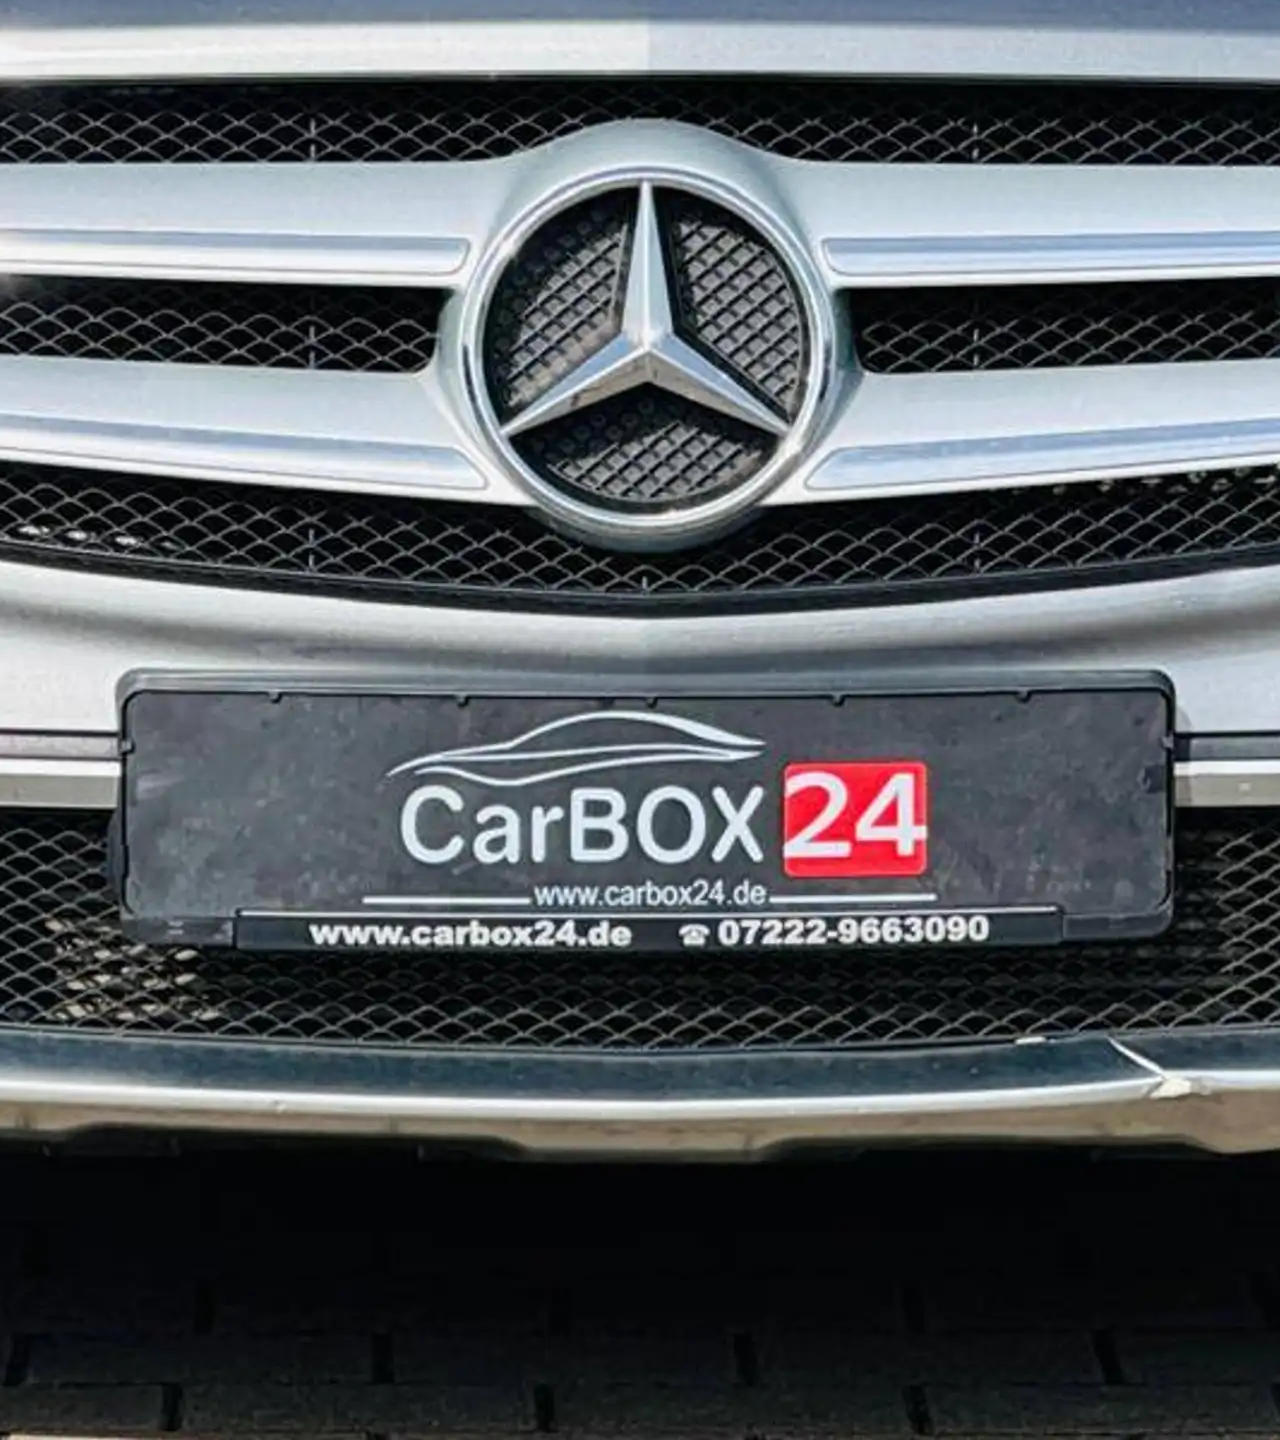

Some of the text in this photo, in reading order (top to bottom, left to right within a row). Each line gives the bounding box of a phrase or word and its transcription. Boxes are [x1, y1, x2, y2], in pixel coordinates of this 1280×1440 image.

[533, 879, 768, 907] www.carbox24.de
[308, 914, 990, 947] www.carbox24.de 07222-9663090
